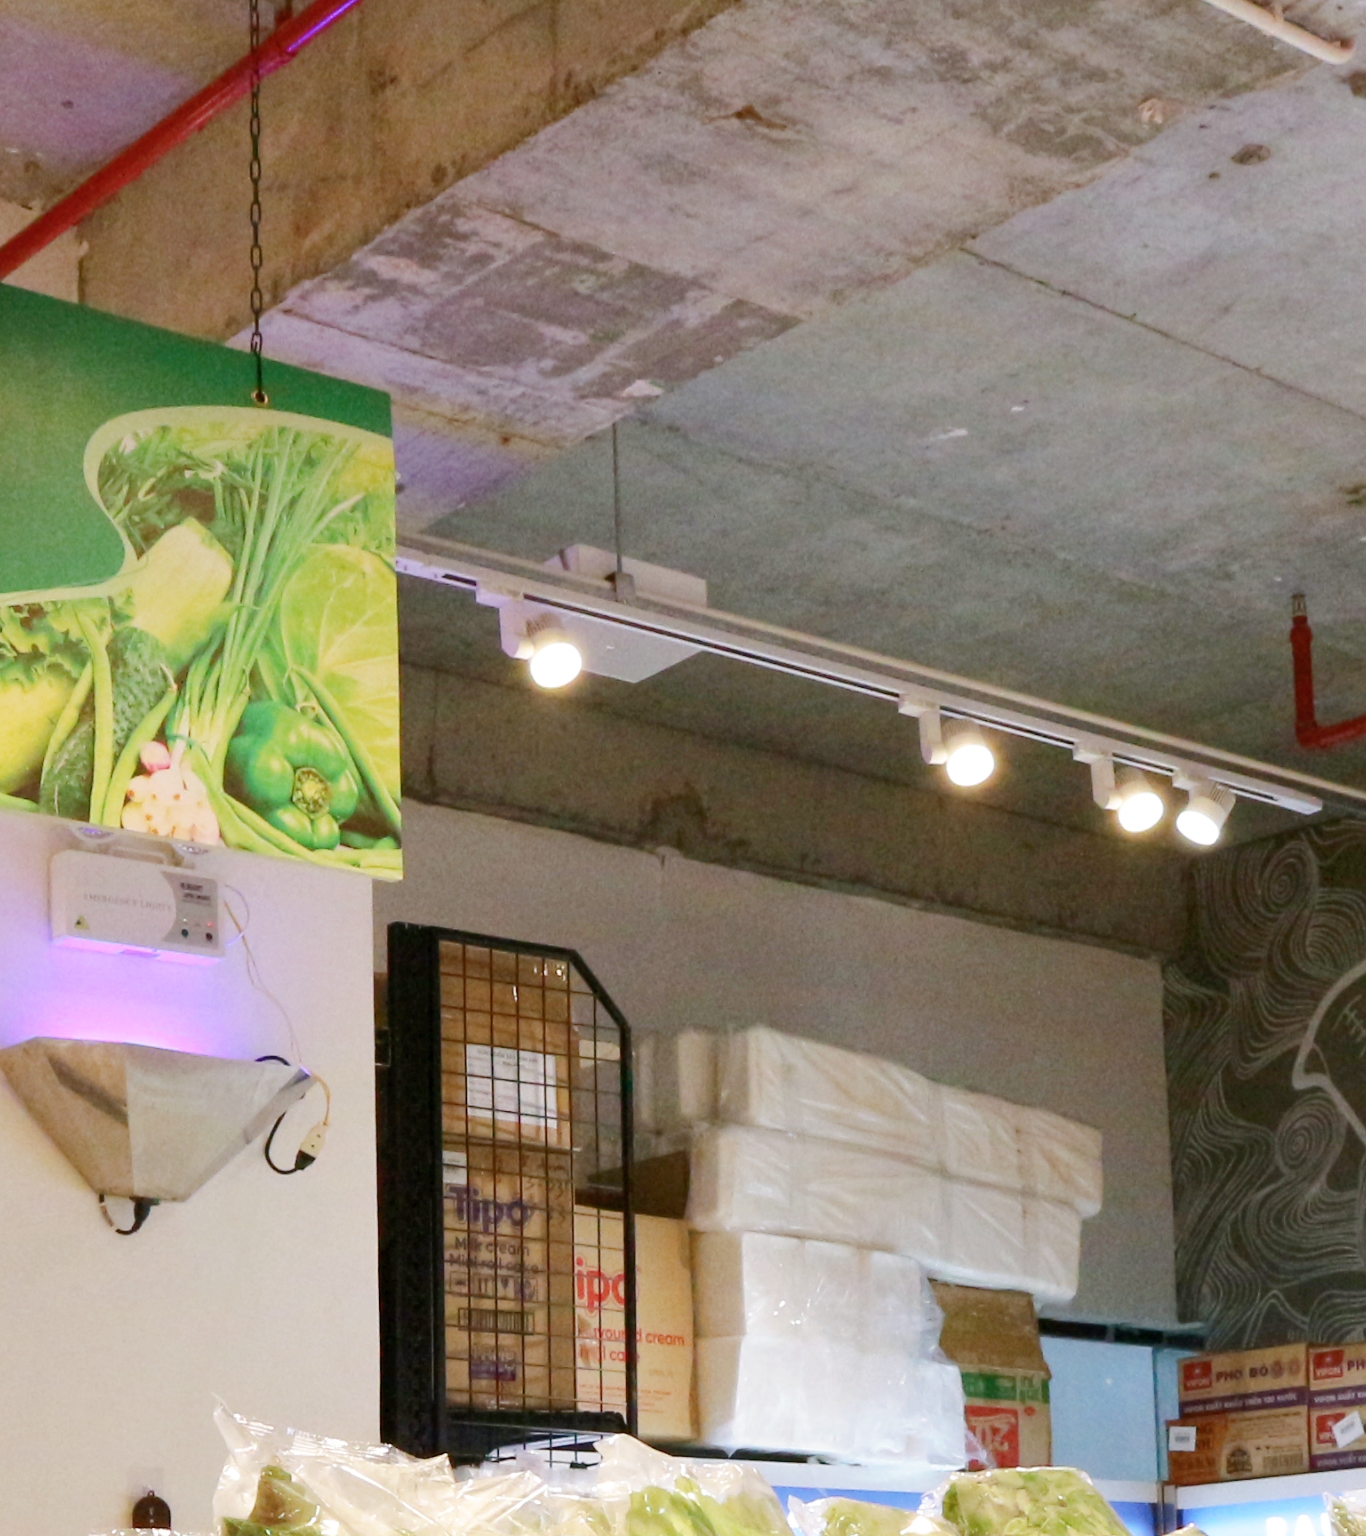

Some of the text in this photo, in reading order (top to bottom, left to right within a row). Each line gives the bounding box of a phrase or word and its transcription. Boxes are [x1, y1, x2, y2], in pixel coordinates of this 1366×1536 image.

[446, 1183, 531, 1235] Tipo
[485, 1240, 529, 1256] cream
[575, 1257, 638, 1315] ipo
[646, 1331, 685, 1346] cream
[1316, 1366, 1341, 1377] VIFON
